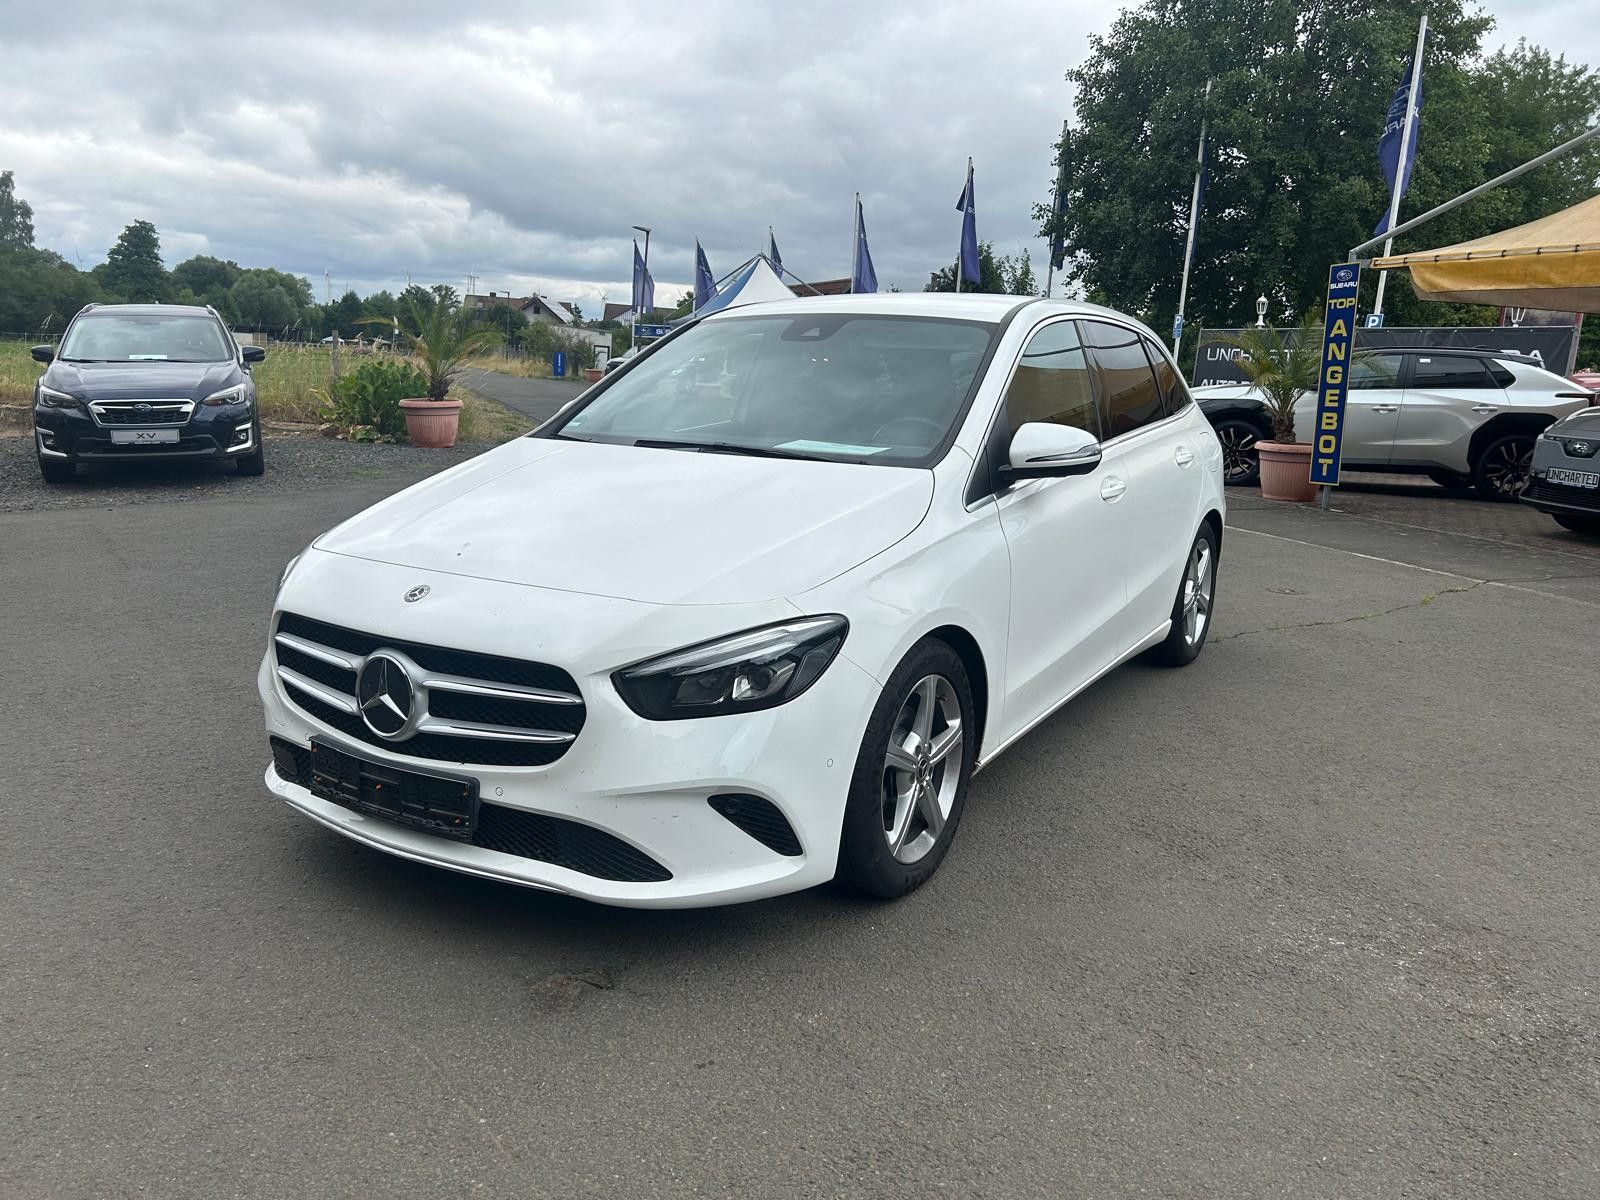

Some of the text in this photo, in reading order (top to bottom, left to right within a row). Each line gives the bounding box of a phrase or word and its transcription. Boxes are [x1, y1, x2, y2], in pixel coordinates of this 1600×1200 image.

[1330, 281, 1358, 290] SUBARU
[1329, 298, 1356, 310] TOP
[1175, 316, 1181, 329] P
[1368, 316, 1380, 328] P
[1318, 319, 1347, 477] ANGEBOT
[136, 432, 156, 440] XV
[1547, 468, 1599, 486] UNCHARTED
